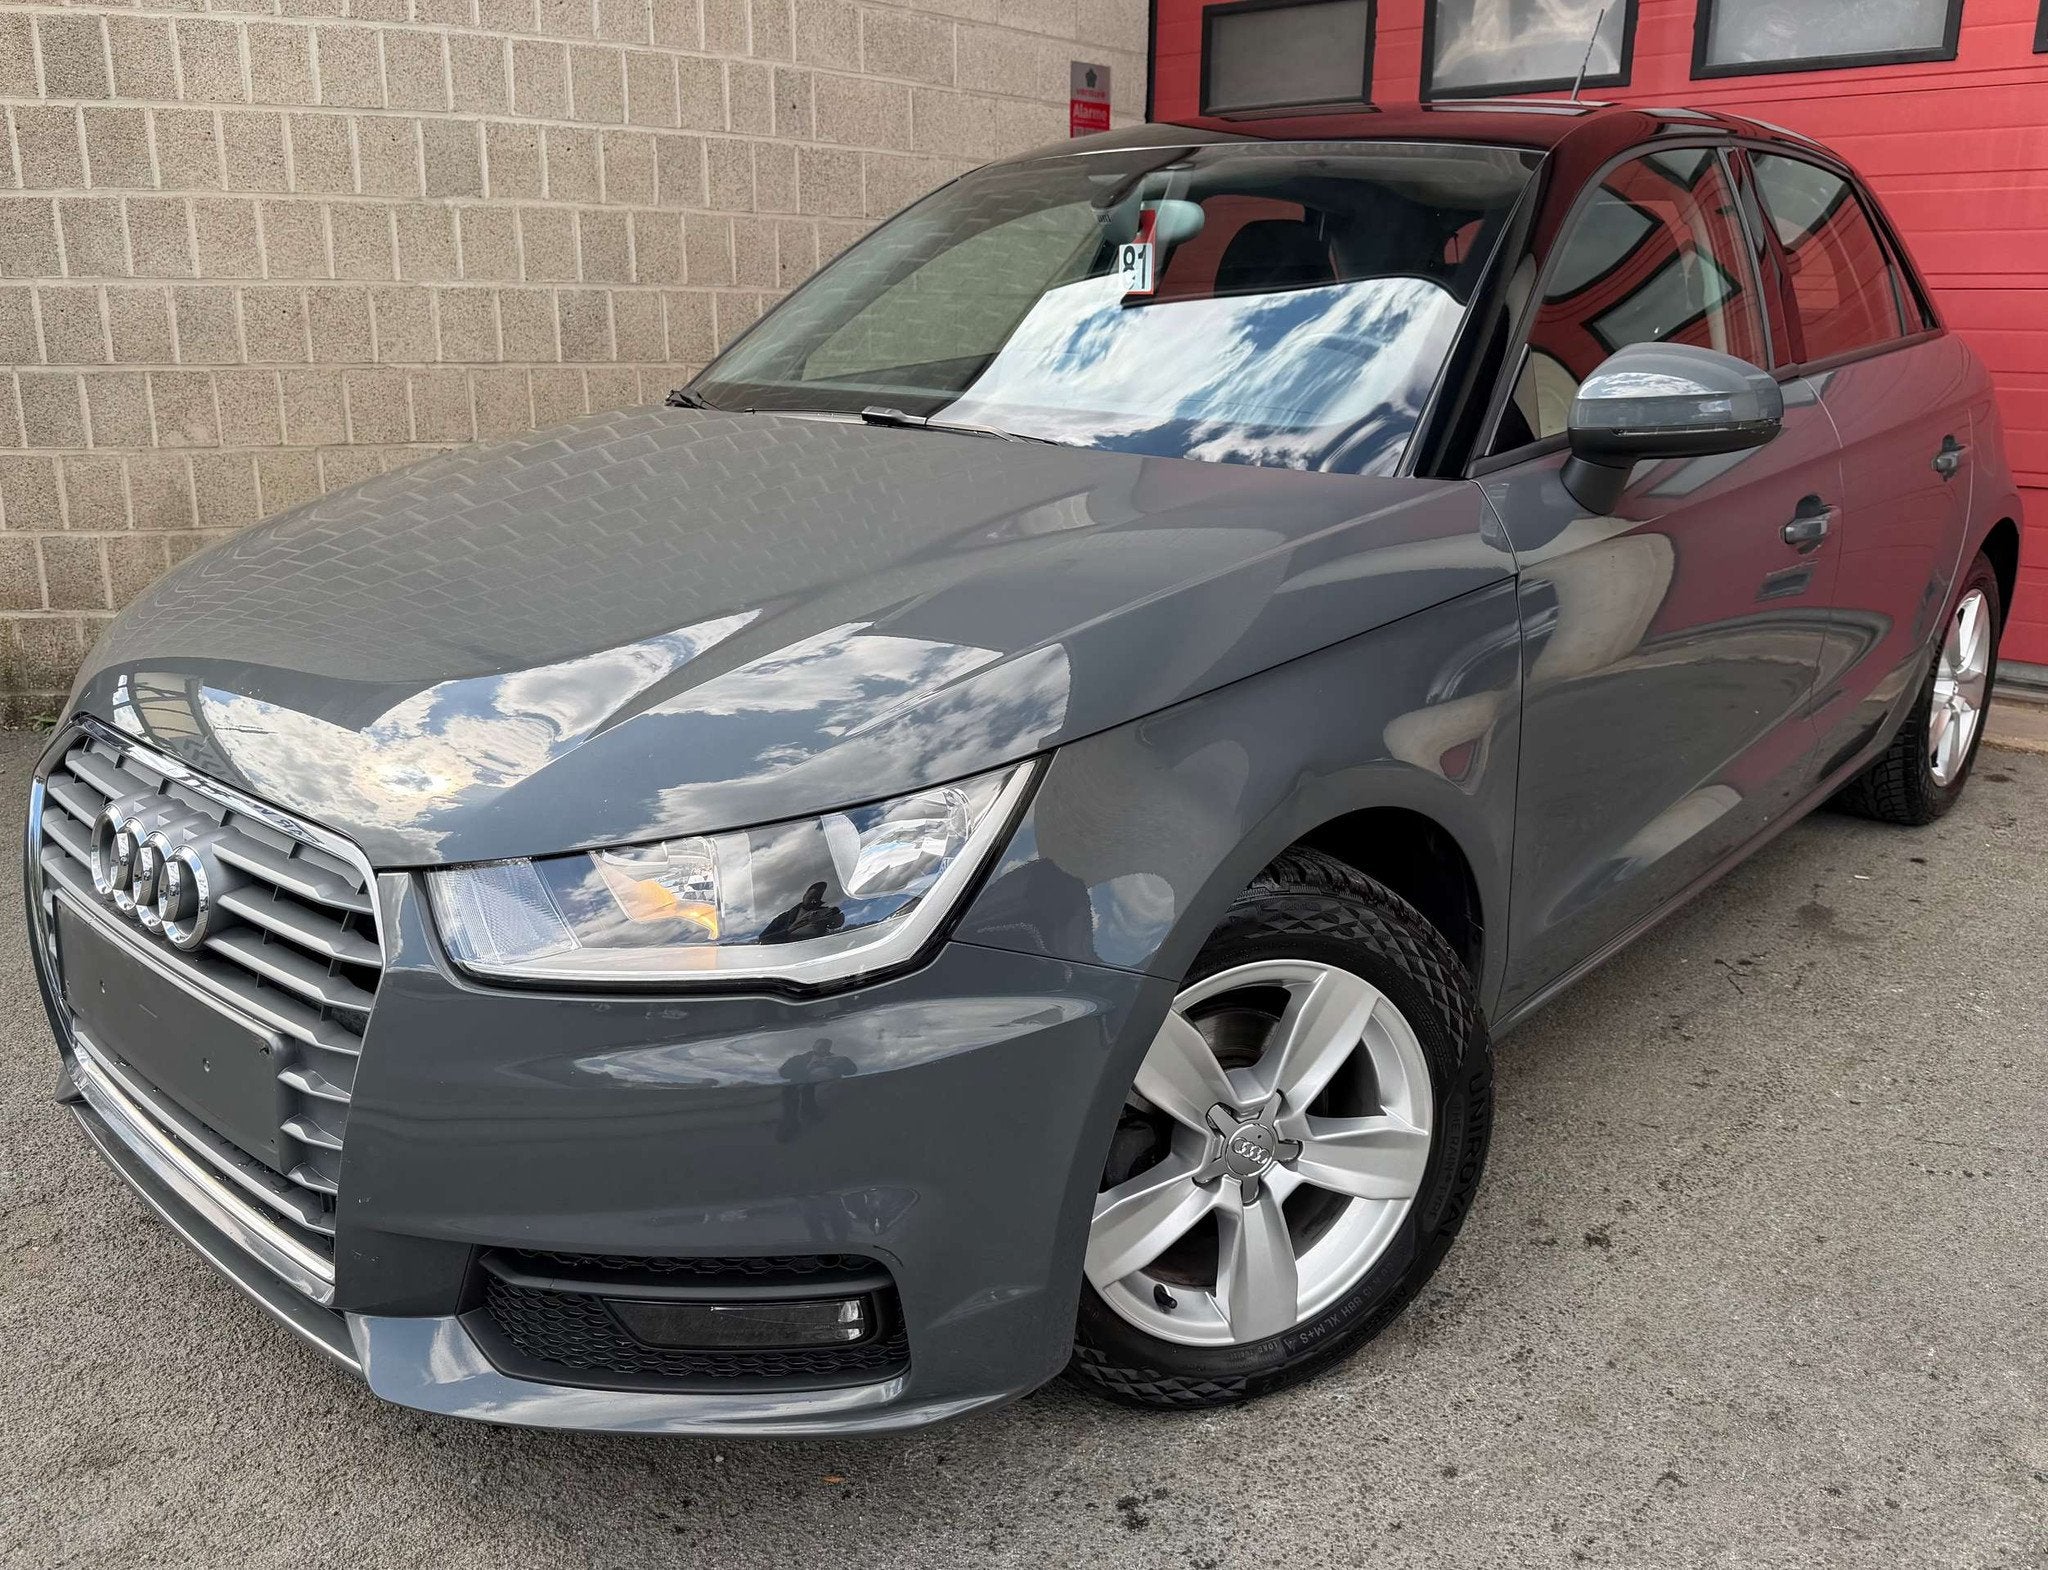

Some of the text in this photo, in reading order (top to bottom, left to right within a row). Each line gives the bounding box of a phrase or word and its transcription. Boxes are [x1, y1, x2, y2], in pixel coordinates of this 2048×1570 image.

[1073, 102, 1108, 120] Alarme
[1431, 1071, 1485, 1246] UNIROYAL
[1325, 1313, 1342, 1328] XL
[1299, 1325, 1326, 1345] M+S
